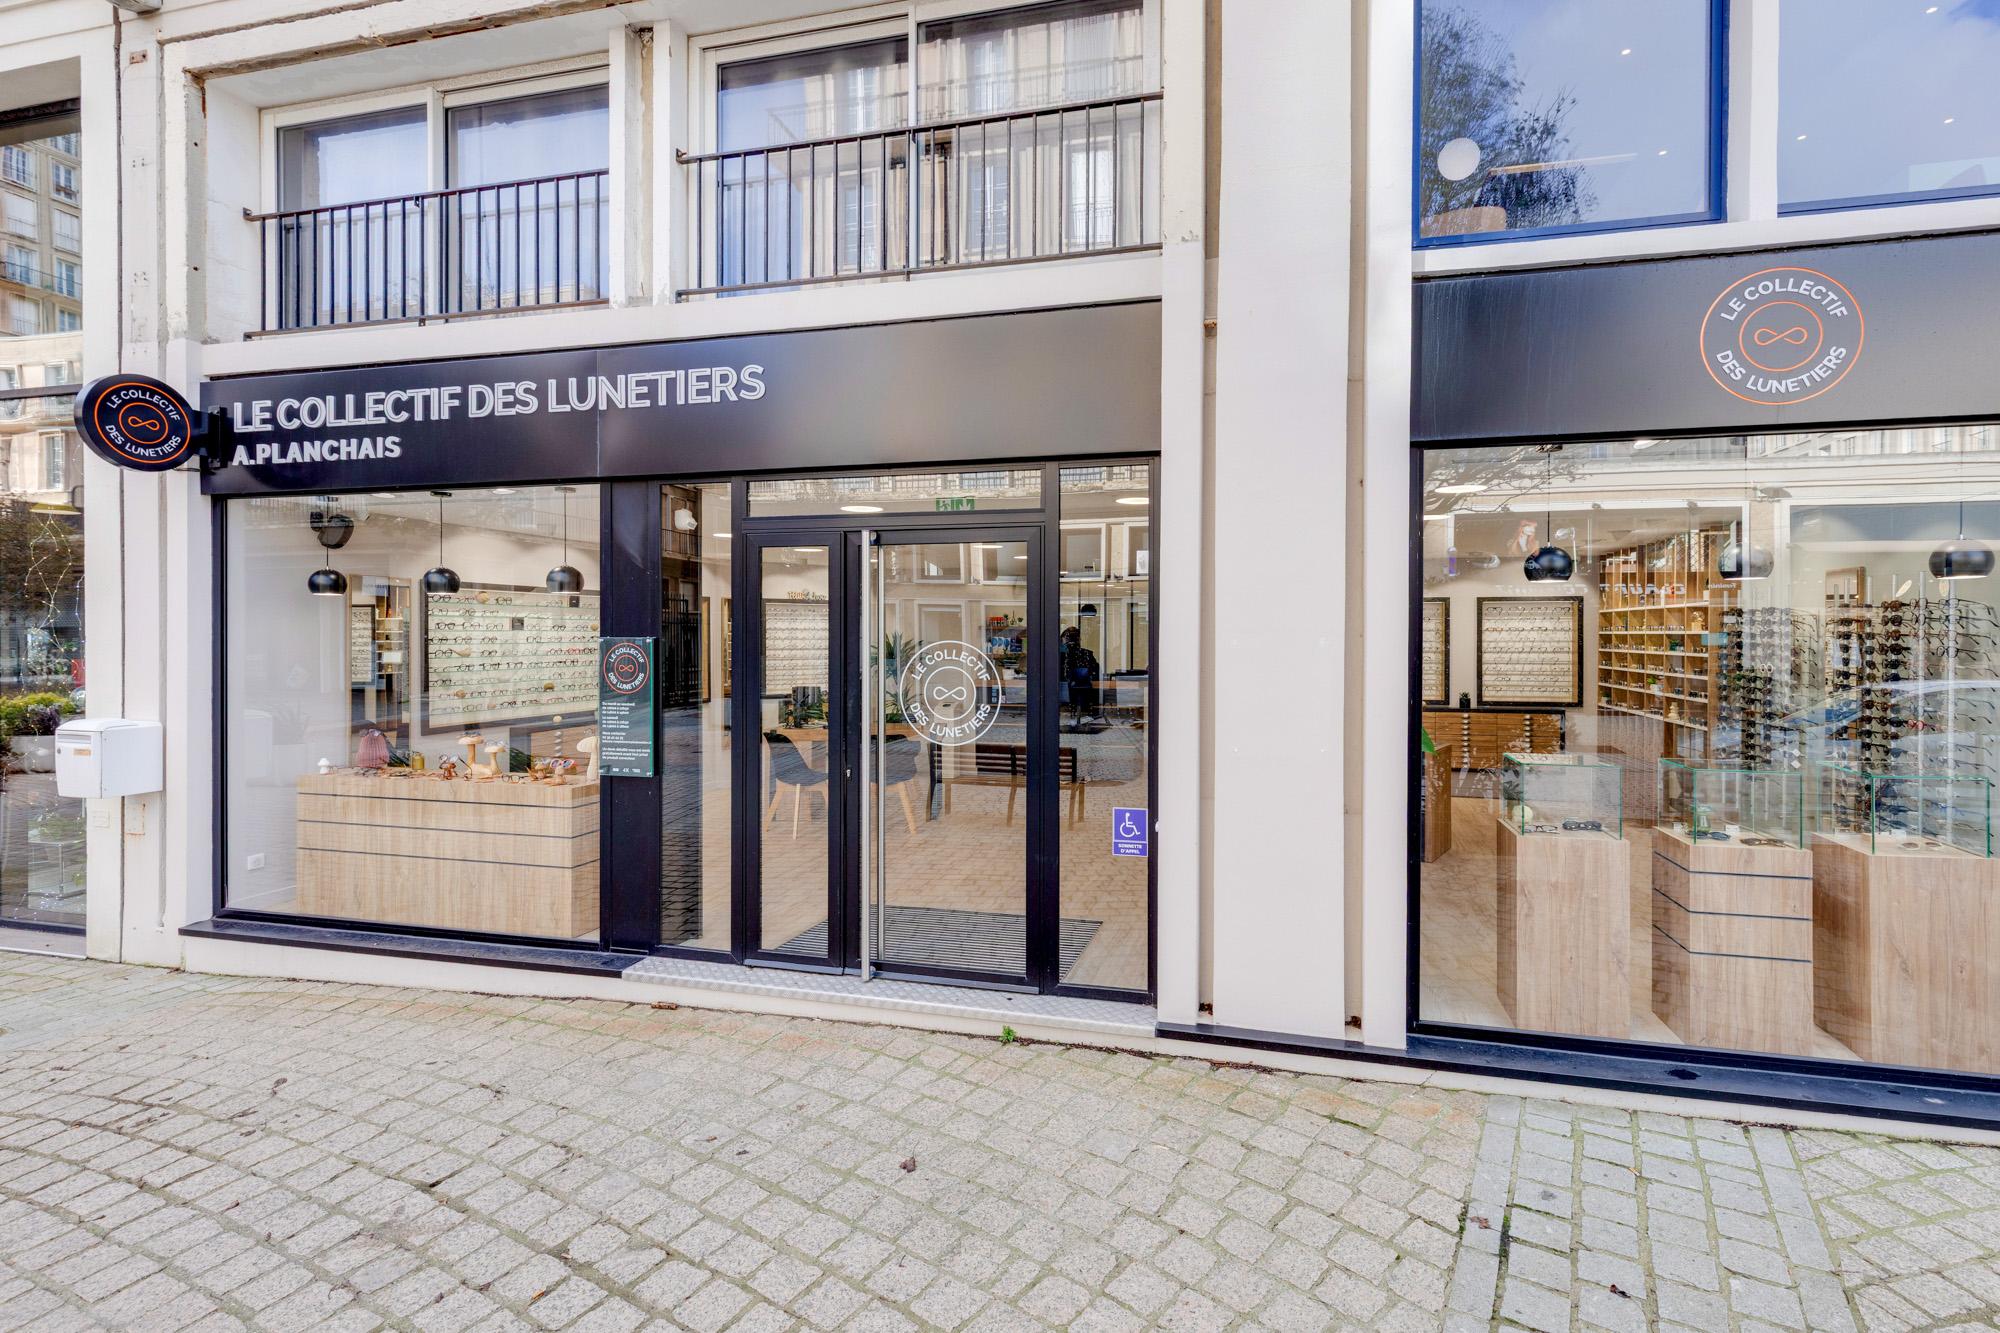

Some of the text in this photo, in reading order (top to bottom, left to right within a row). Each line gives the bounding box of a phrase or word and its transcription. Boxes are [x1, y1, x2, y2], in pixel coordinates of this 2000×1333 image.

[1719, 277, 1849, 322] LE COLLECTIF
[1716, 345, 1848, 394] DES LUNETIERS
[106, 389, 181, 423] LE COLLECTIF
[233, 364, 767, 433] LE COLLECTIF DES LUNETIERS
[105, 424, 182, 457] DES LUNETIERS
[232, 435, 402, 467] A.PLANCHAIS
[608, 647, 645, 663] LE COLLECTIF
[911, 649, 991, 681] LE COLLECTIF
[608, 672, 645, 690] DES LUNETIERS
[910, 702, 991, 738] DES LUNETIERS
